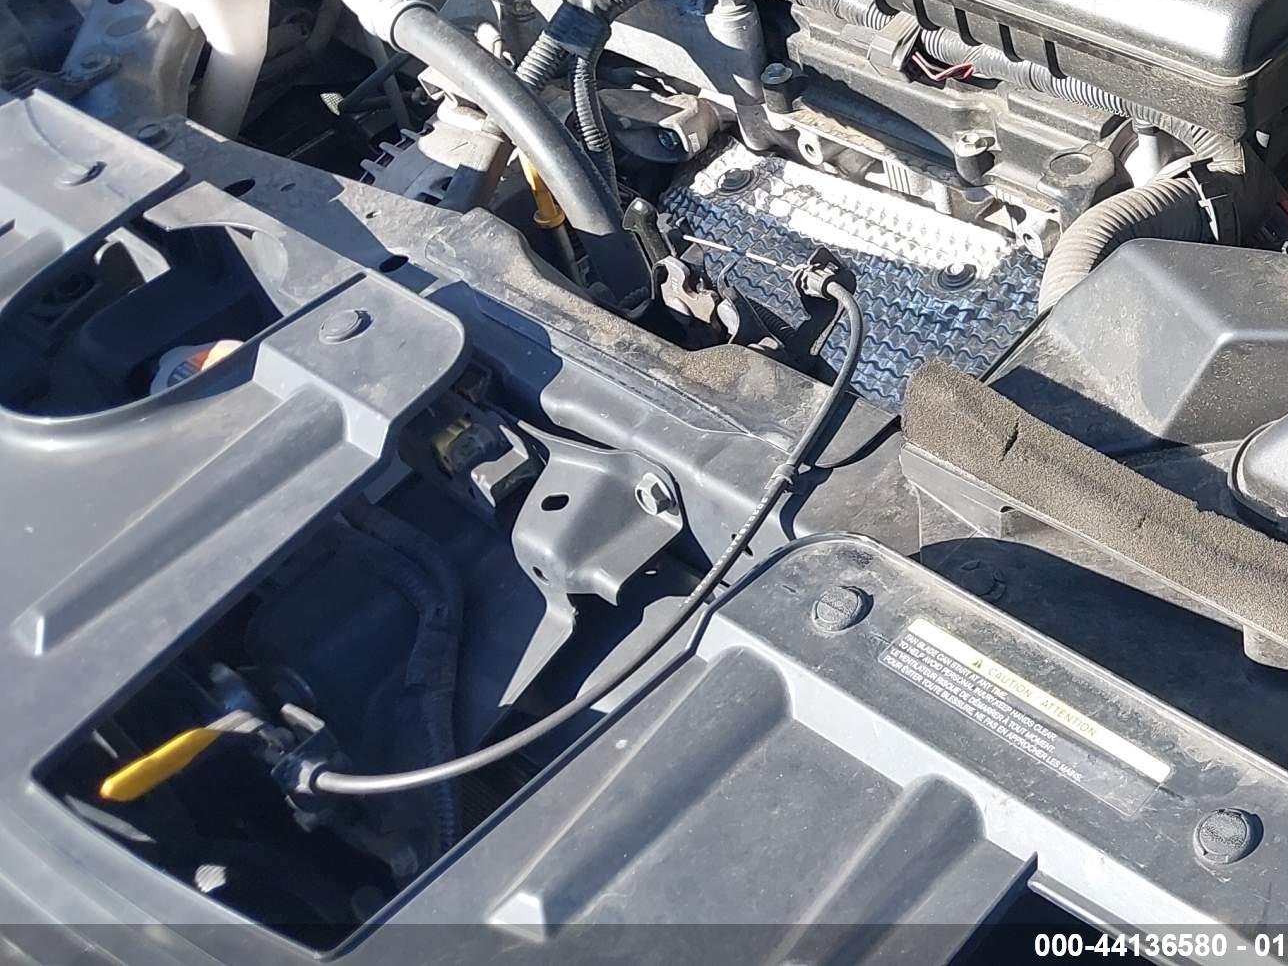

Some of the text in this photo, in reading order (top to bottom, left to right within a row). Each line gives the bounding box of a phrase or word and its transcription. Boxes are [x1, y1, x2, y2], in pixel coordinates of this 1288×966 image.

[898, 641, 910, 650] TO
[906, 646, 926, 660] HELP
[921, 655, 944, 671] AVOID
[941, 667, 976, 691] PERSONAL
[1009, 709, 1035, 727] HANDS
[935, 653, 953, 666] CAN
[949, 661, 972, 678] START
[968, 673, 980, 683] AT
[987, 667, 1098, 737] CAUTION ATTENTION
[882, 655, 904, 670] POUR
[973, 711, 986, 721] NE
[983, 716, 999, 729] PAS
[996, 724, 1010, 735] EN
[1046, 755, 1061, 767] LES
[958, 690, 971, 701] DE
[1008, 721, 1028, 736] TOUT
